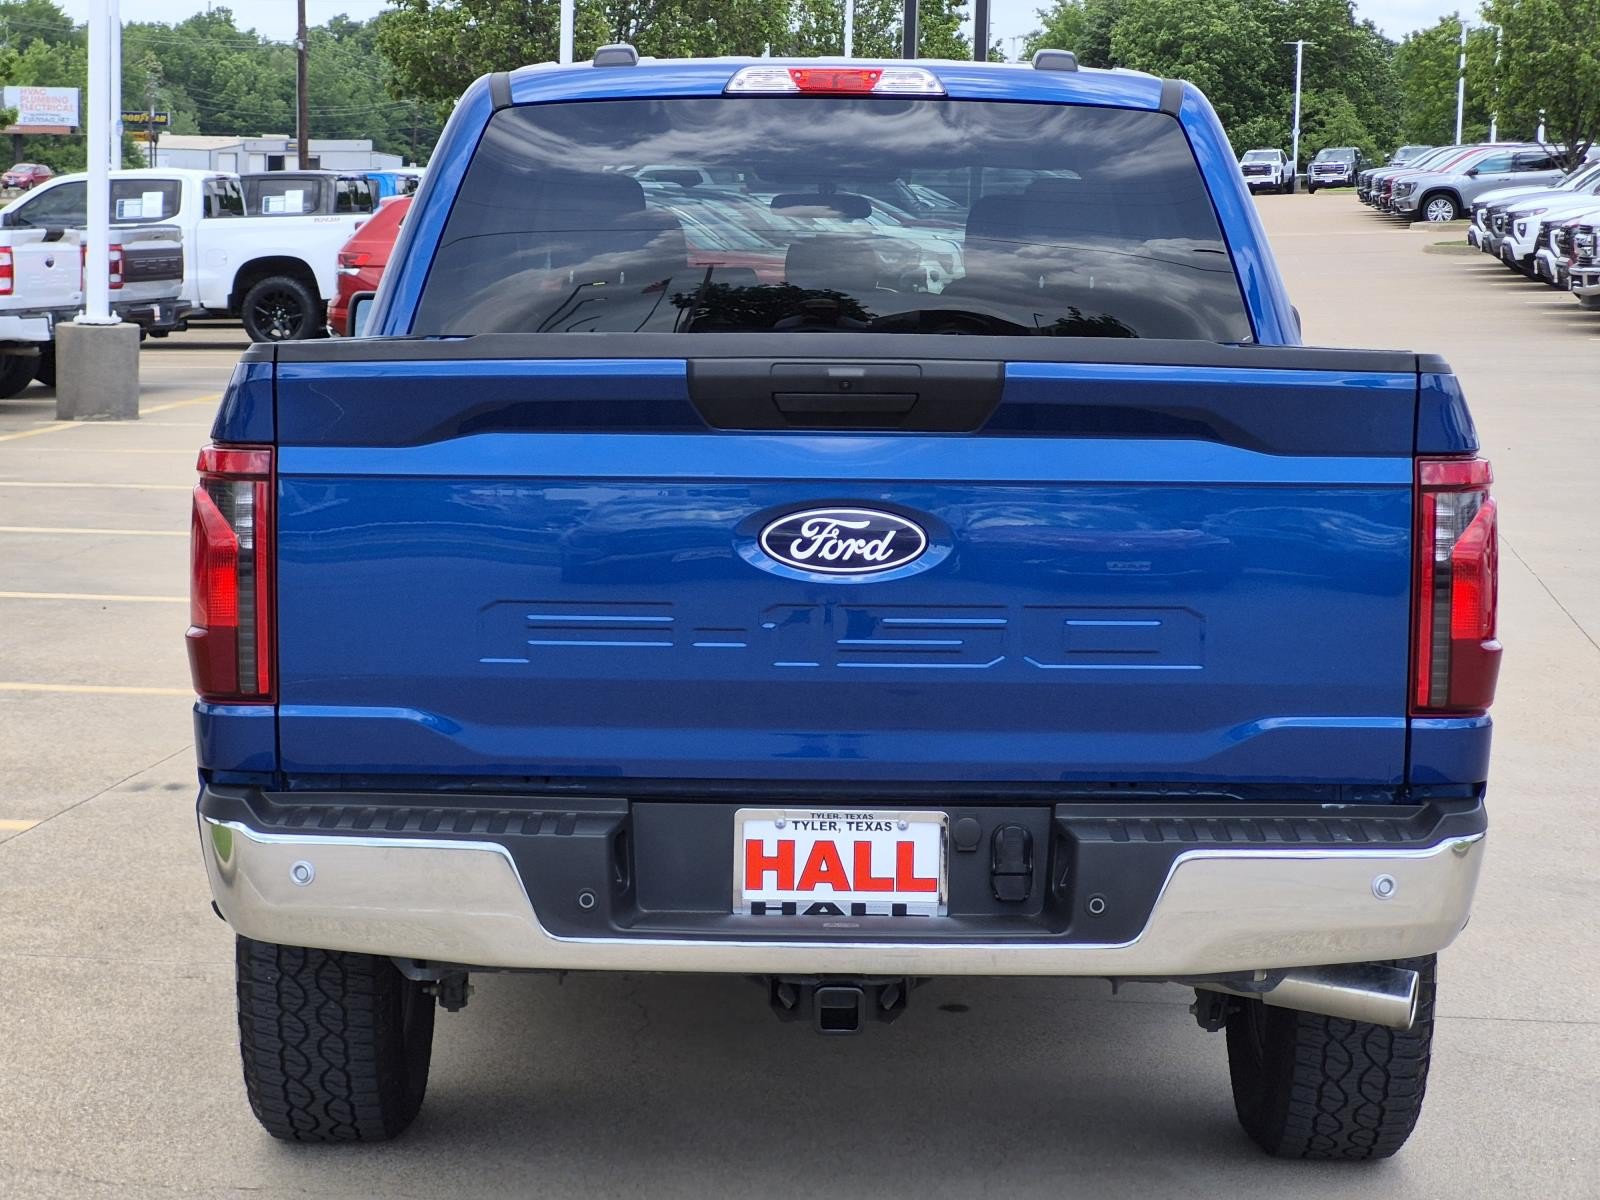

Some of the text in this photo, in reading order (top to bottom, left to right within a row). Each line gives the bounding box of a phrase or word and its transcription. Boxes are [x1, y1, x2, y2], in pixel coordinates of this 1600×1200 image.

[20, 96, 69, 104] PLUMBING
[790, 517, 897, 561] Ford
[479, 600, 1206, 672] F-150
[792, 820, 892, 833] TYLER, TEXAS
[745, 839, 938, 893] HALL
[750, 901, 930, 917] HALL
